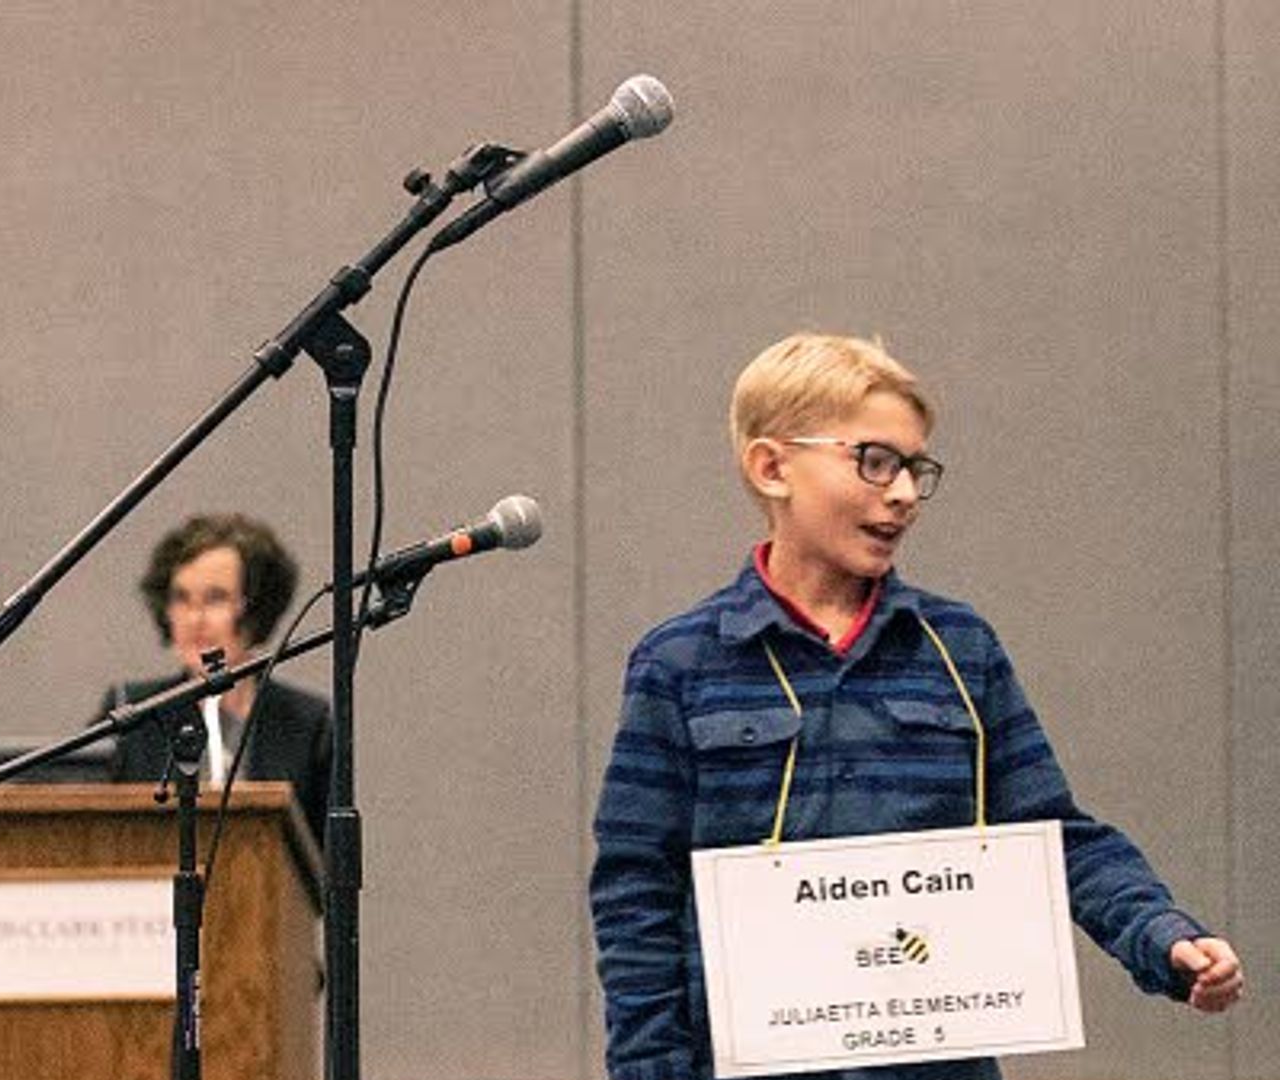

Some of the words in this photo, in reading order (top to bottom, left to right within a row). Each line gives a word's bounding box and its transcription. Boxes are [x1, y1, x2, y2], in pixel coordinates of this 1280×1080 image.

[795, 876, 890, 904] Aiden
[901, 867, 975, 895] Cain
[855, 946, 903, 968] BEE
[769, 1001, 881, 1027] JULIAETTA
[886, 991, 1025, 1017] ELEMENTARY
[843, 1027, 916, 1051] GRADE
[934, 1026, 945, 1043] 5
